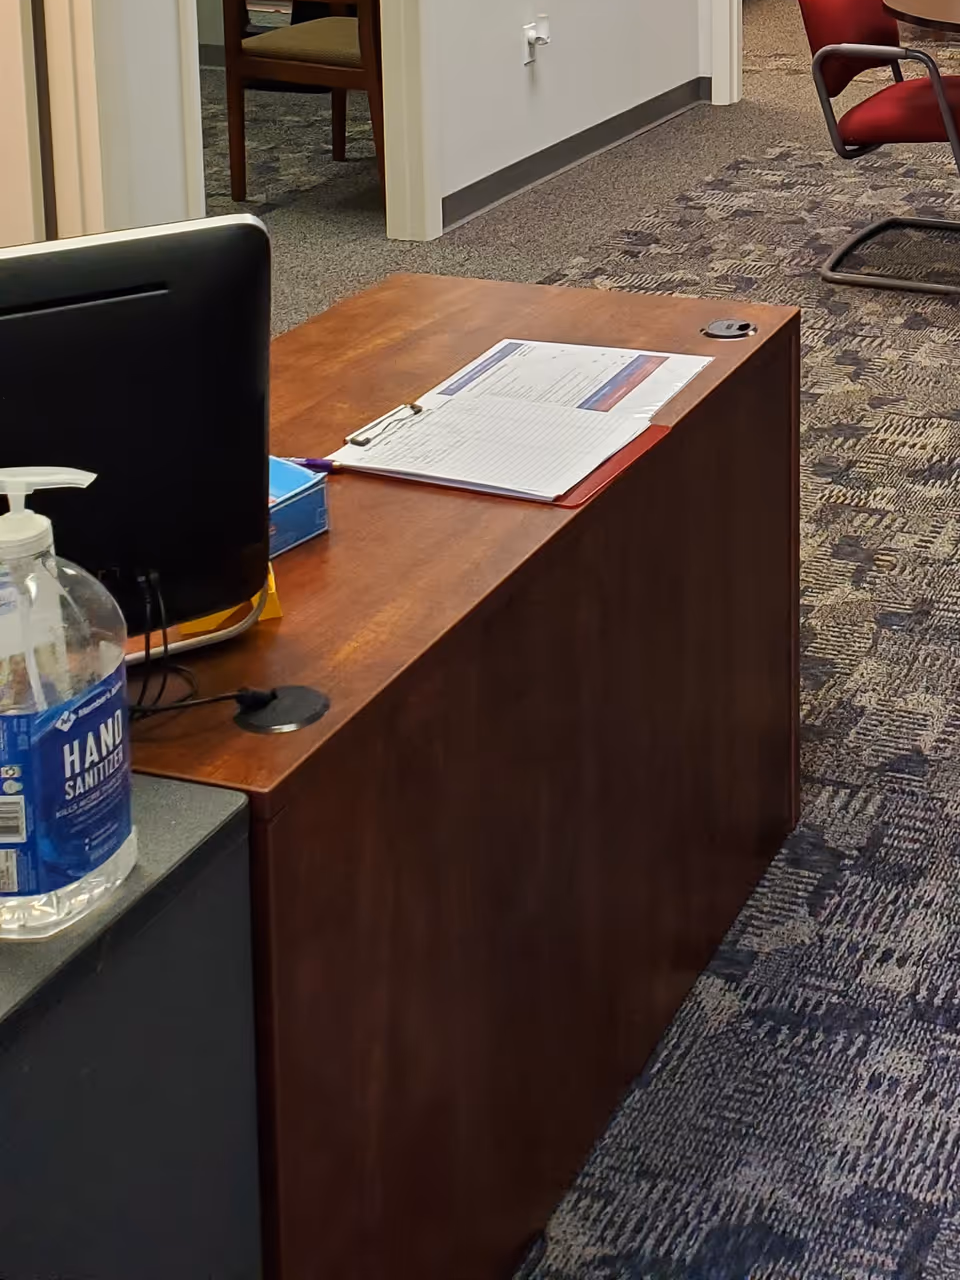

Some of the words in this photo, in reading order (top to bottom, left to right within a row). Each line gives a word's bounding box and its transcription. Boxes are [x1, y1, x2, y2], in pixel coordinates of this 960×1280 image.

[64, 709, 123, 778] HAND
[65, 745, 123, 800] SANITIZER
[56, 802, 78, 818] KILLS
